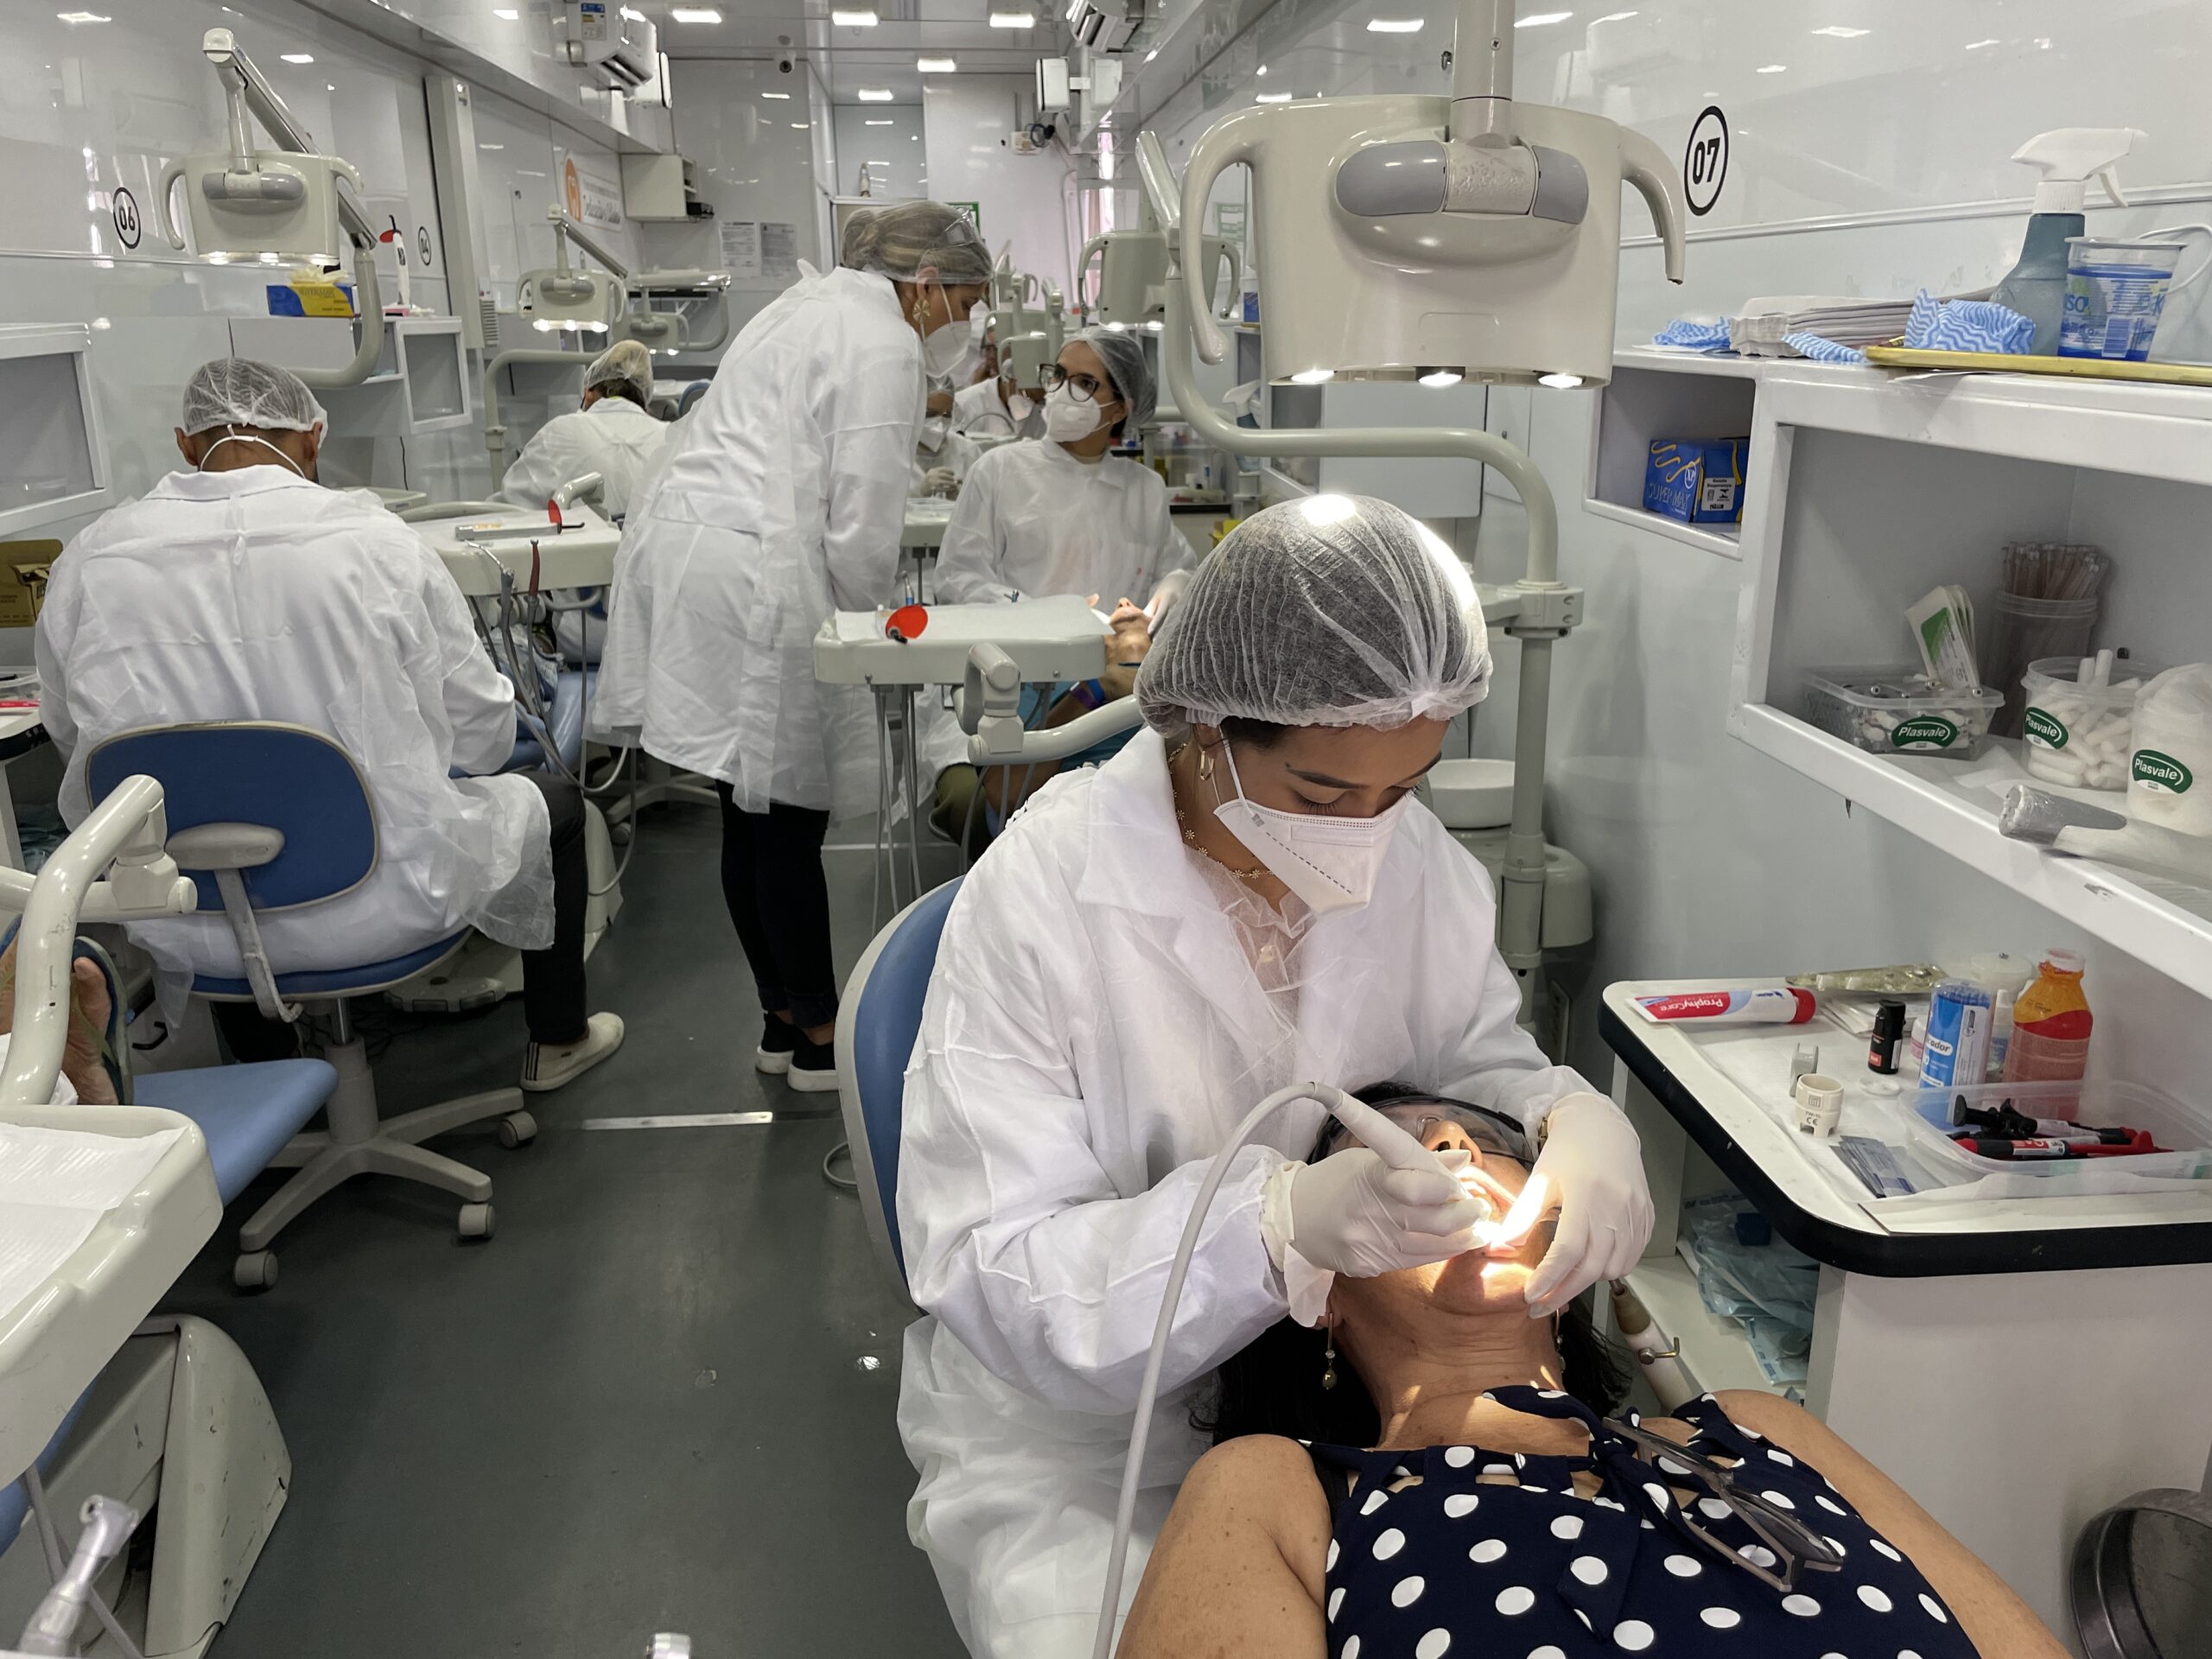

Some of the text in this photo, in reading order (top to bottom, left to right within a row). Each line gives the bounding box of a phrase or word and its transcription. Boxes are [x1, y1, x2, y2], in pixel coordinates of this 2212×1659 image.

[1692, 137, 1720, 185] 07
[118, 205, 136, 232] 06
[1898, 726, 1946, 738] Plasvale
[2024, 714, 2057, 737] Plasvale
[2134, 758, 2177, 780] Plasvale
[1660, 998, 1724, 1012] ProphyCare
